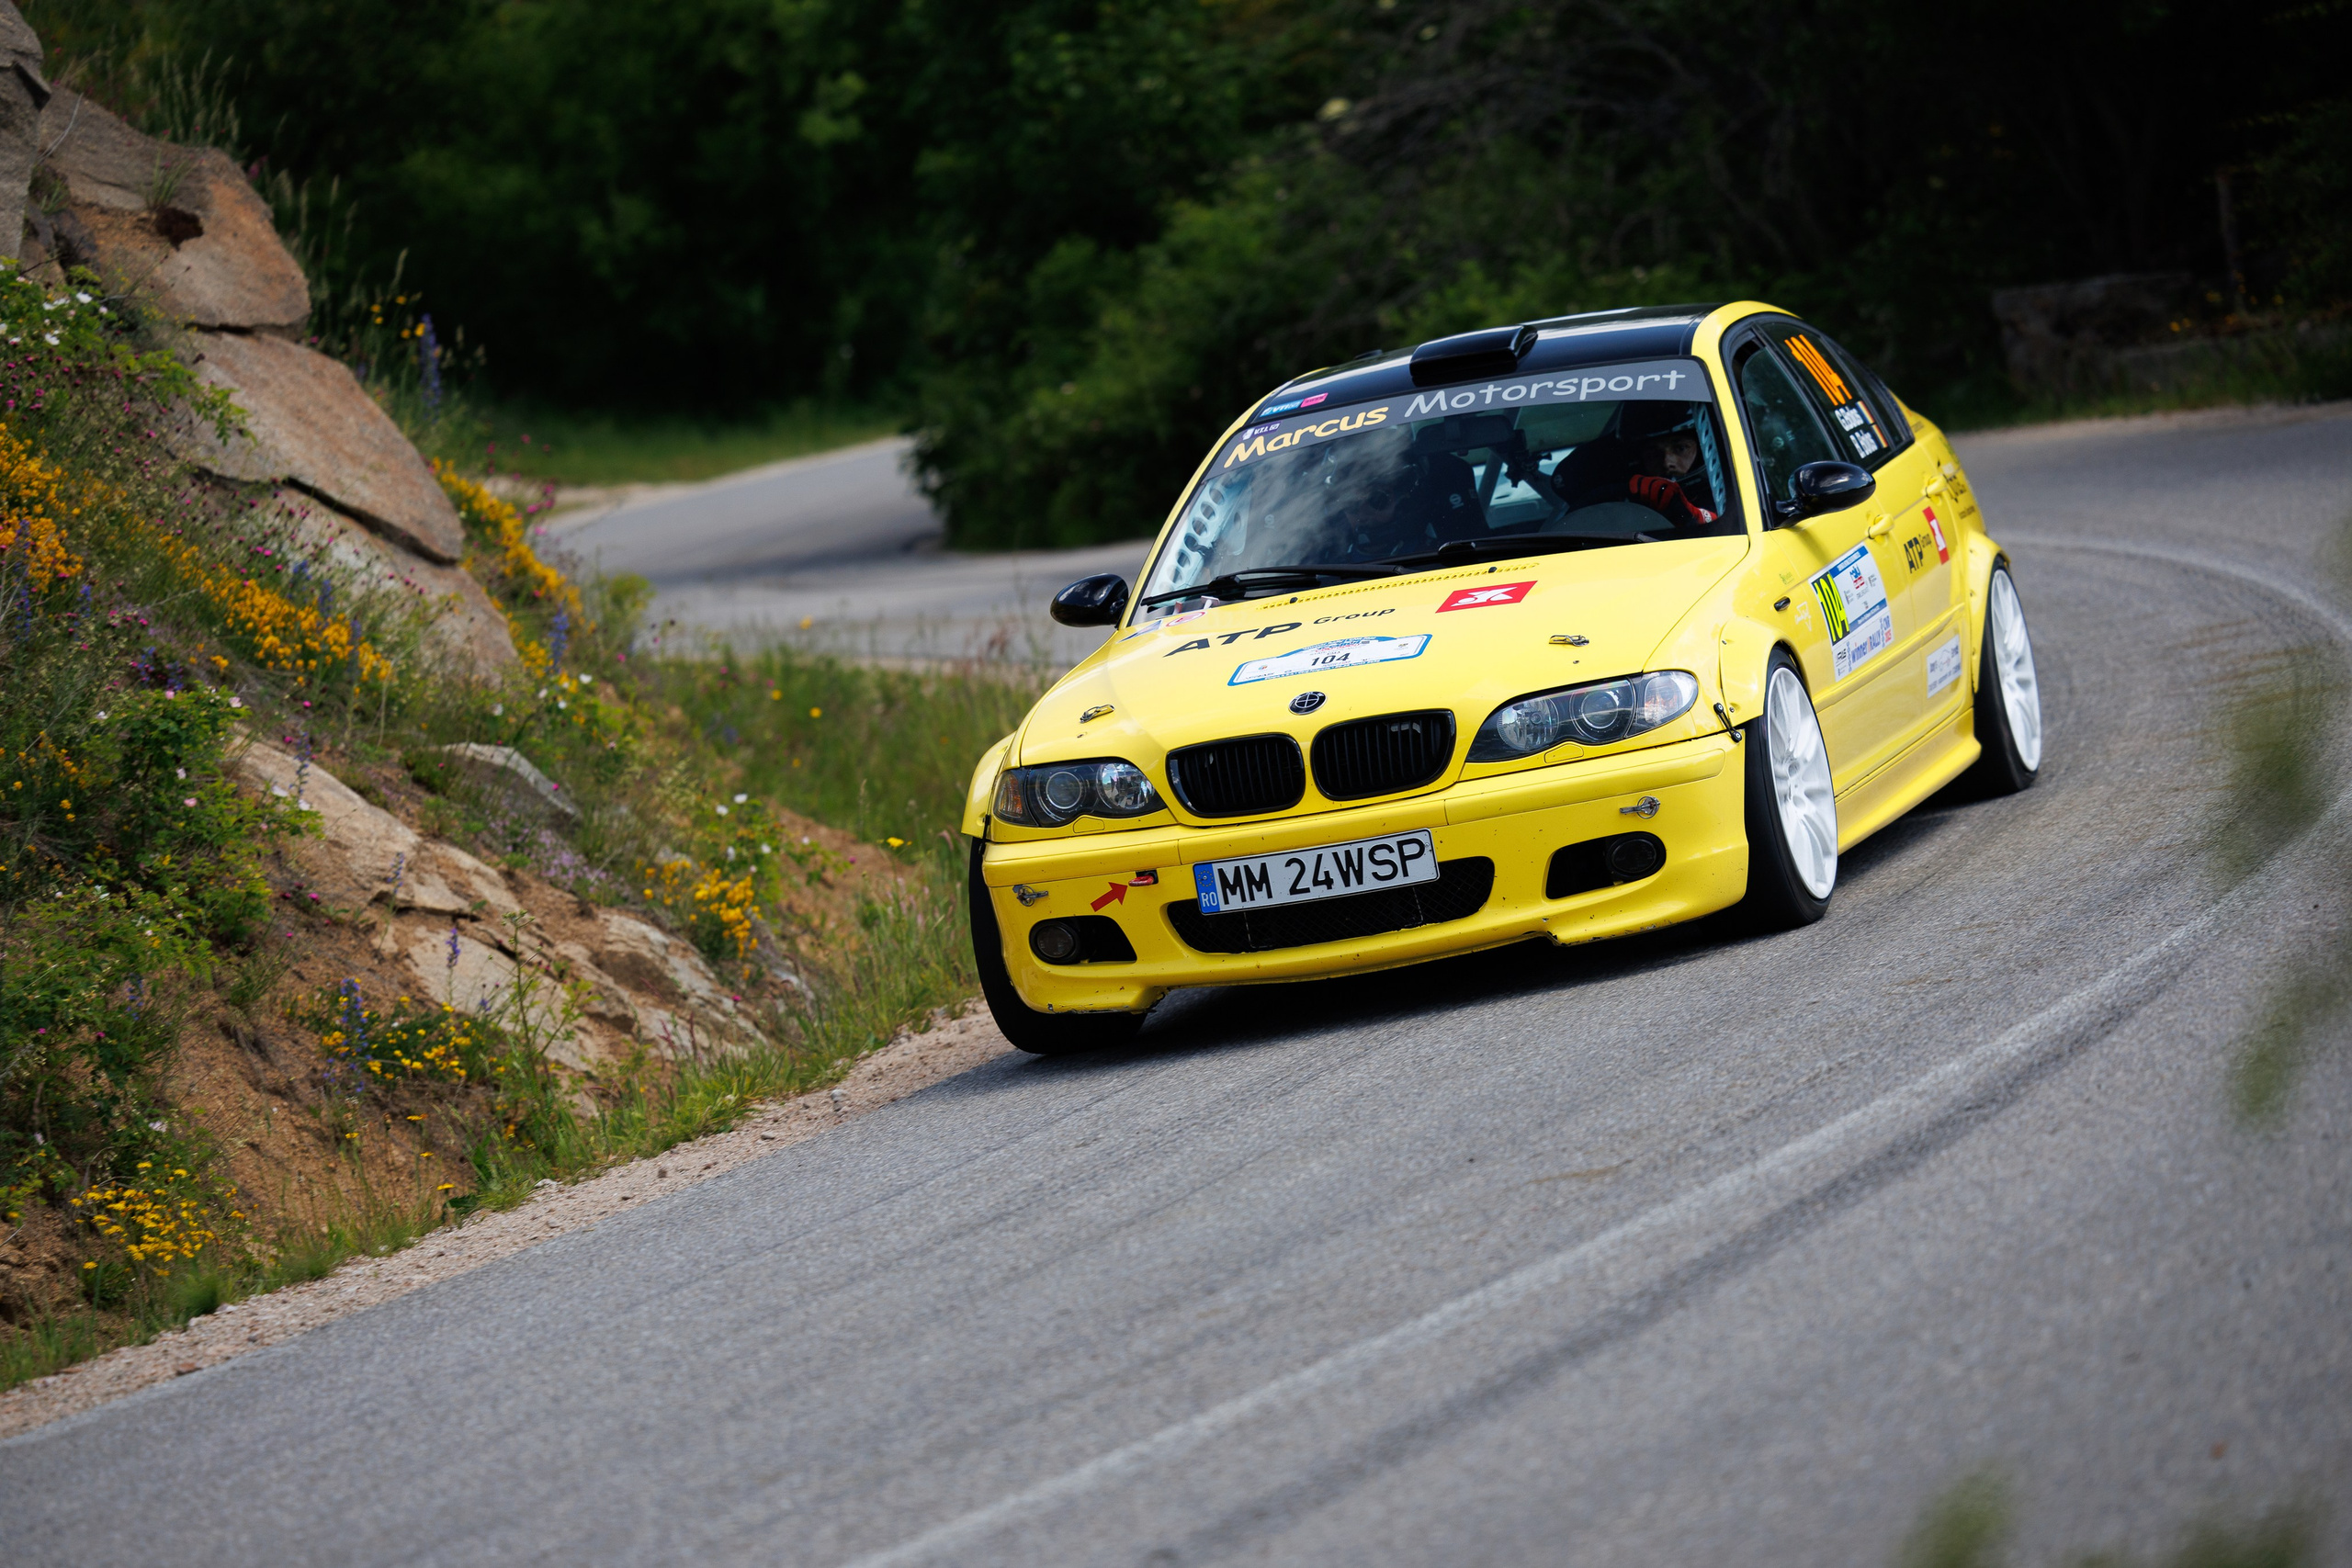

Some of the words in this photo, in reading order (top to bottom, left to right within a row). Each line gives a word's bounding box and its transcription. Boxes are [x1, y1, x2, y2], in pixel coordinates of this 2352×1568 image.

[1784, 334, 1852, 406] 104
[1224, 406, 1389, 468] Marcus
[1404, 369, 1686, 418] Motorsport
[1904, 536, 1923, 573] ATP
[1163, 622, 1303, 658] ATP
[1313, 608, 1396, 625] Group
[1814, 573, 1849, 643] 104
[1311, 652, 1351, 666] 104
[1201, 891, 1218, 908] RO
[1217, 862, 1273, 905] MM
[1284, 838, 1426, 896] 24WSP
